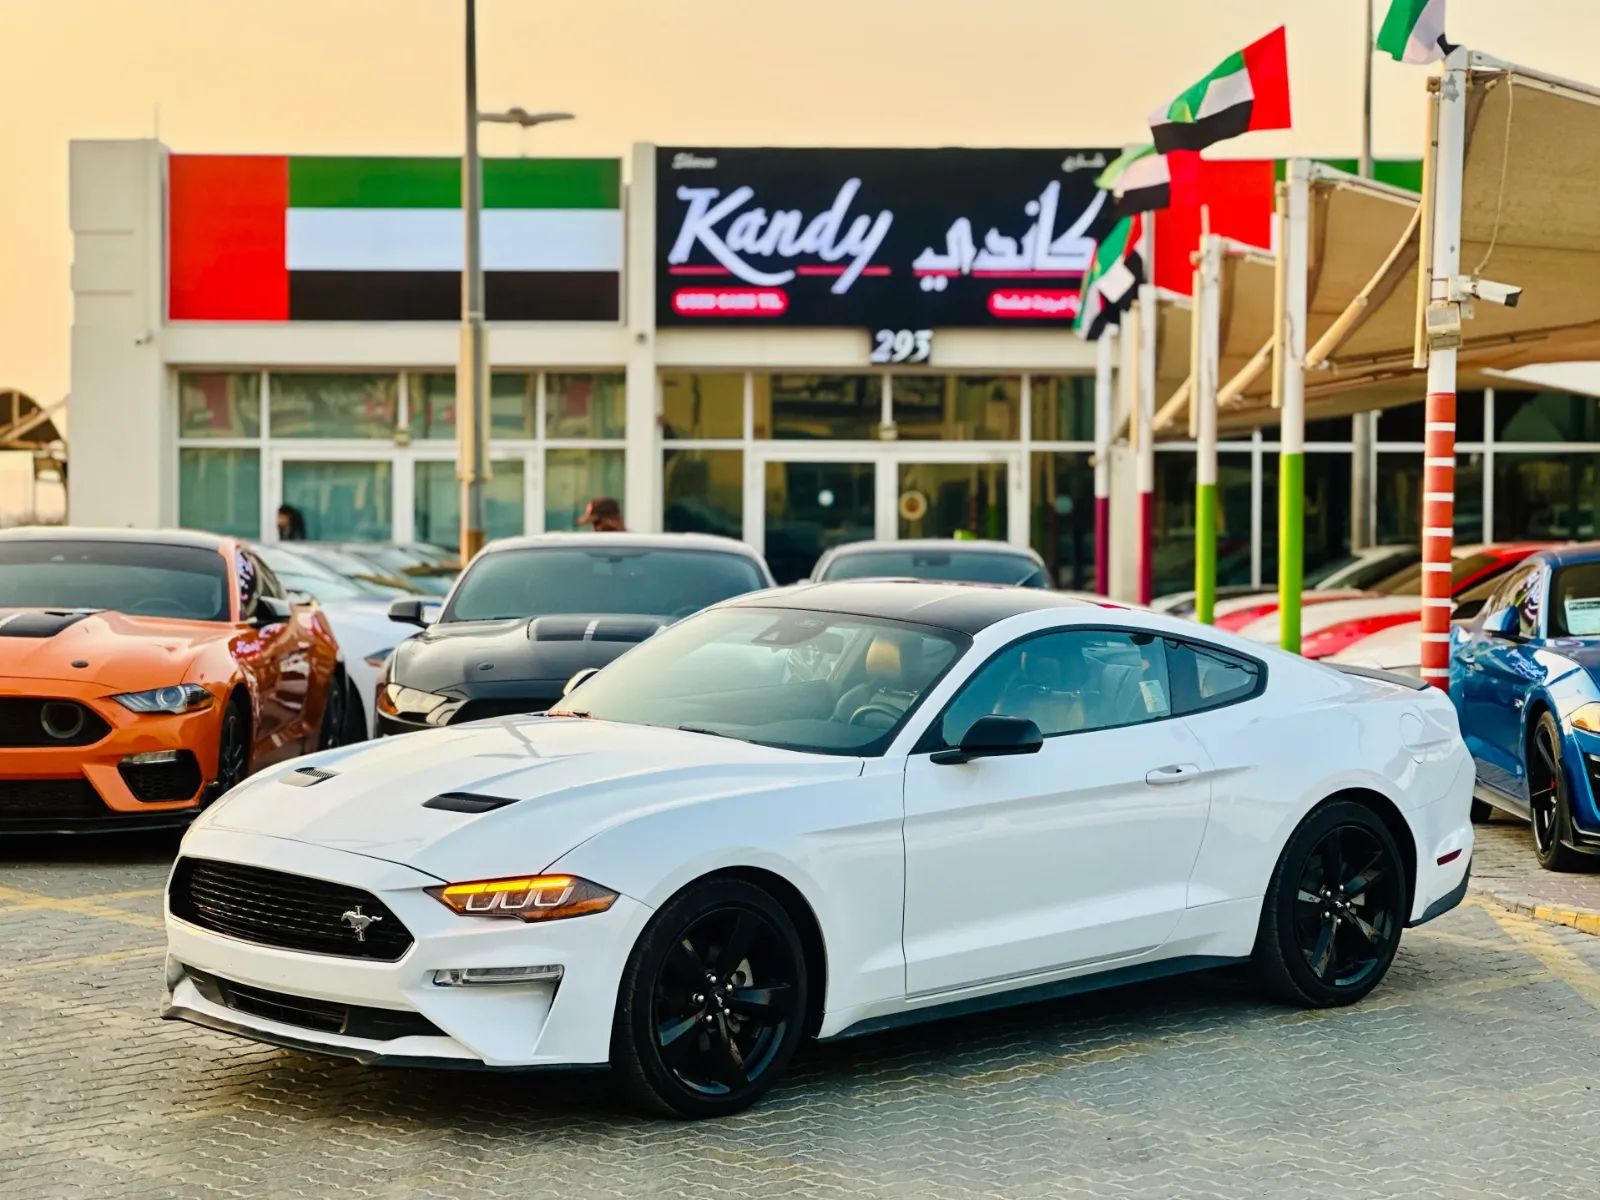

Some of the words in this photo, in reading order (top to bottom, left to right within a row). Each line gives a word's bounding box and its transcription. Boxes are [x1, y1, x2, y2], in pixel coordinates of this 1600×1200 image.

[668, 177, 893, 294] Kandy
[912, 180, 1107, 291] كاندي
[869, 329, 933, 362] 295
